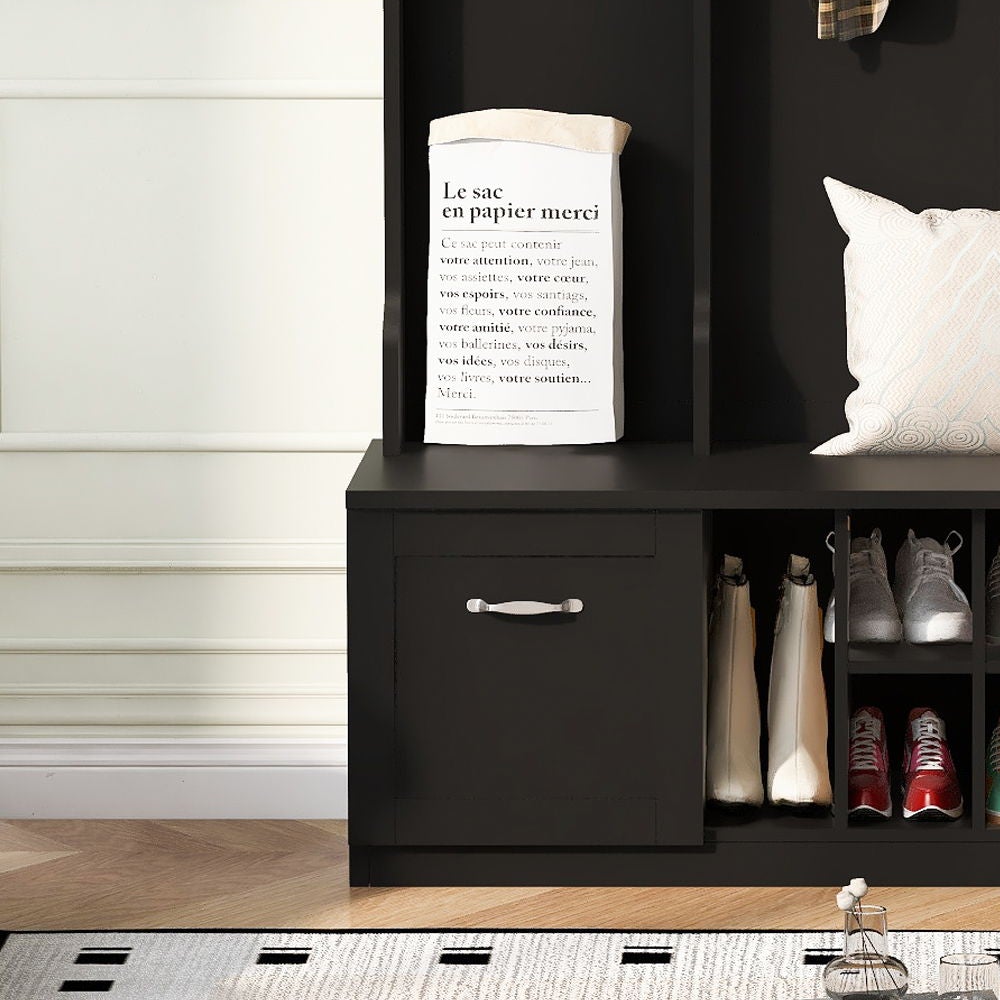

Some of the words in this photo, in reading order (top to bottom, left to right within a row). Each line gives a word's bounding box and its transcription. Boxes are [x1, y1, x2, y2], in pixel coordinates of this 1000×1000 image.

[443, 181, 467, 200] Le
[472, 187, 504, 200] sac
[442, 206, 464, 218] en
[470, 203, 536, 224] papier
[540, 205, 599, 220] merci
[441, 237, 458, 249] Ce
[461, 240, 477, 249] sac
[481, 239, 506, 251] peut
[510, 240, 563, 249] contenir
[440, 257, 470, 265] votre
[472, 256, 533, 267] attention,
[536, 258, 568, 266] votre
[569, 257, 598, 270] jean,
[439, 273, 458, 281] vos
[461, 272, 513, 283] assiettes,
[517, 274, 550, 283] votre
[440, 290, 460, 298] vos
[462, 289, 509, 302] espoirs,
[513, 291, 533, 299] vos
[536, 290, 588, 303] santiags,
[439, 307, 458, 315] vos
[461, 305, 495, 317] fleurs,
[499, 308, 531, 316] votre
[534, 305, 597, 318] confiance,
[439, 324, 469, 332] votre
[472, 322, 514, 334] amitié,
[517, 325, 548, 333] votre
[551, 324, 596, 337] pyjama,
[438, 340, 458, 348] vos
[461, 338, 521, 350] ballerines,
[526, 342, 546, 350] vos
[548, 339, 588, 352] désirs,
[438, 357, 459, 366] vos
[462, 355, 496, 368] idées,
[500, 358, 520, 366] vos
[524, 355, 570, 369] disques,
[438, 374, 456, 382] vos
[460, 372, 495, 384] livres,
[499, 376, 531, 384] votre
[437, 387, 477, 399] Merci.
